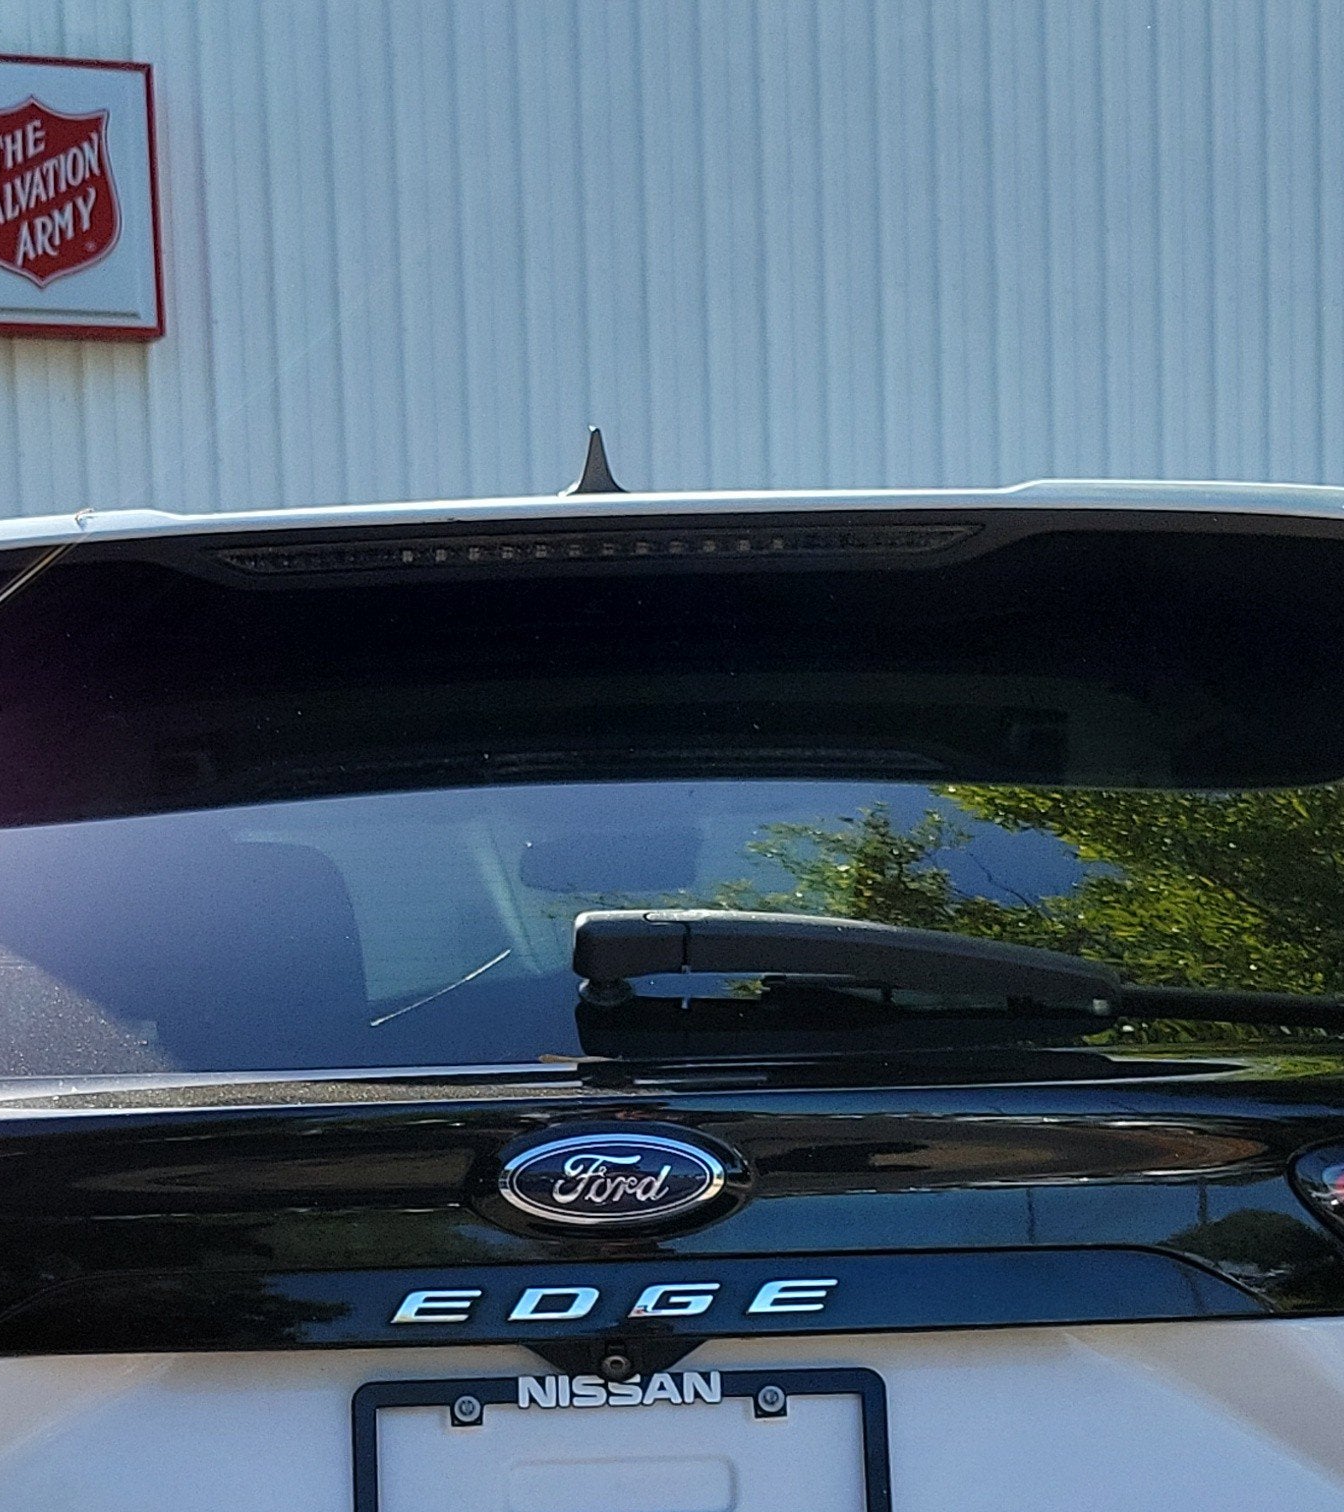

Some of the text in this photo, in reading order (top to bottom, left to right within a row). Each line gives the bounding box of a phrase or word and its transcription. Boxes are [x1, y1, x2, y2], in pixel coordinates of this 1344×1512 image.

[14, 186, 97, 267] ARMY
[552, 1153, 672, 1204] Ford
[390, 1278, 838, 1325] EDGE
[517, 1371, 722, 1408] NISSAN
